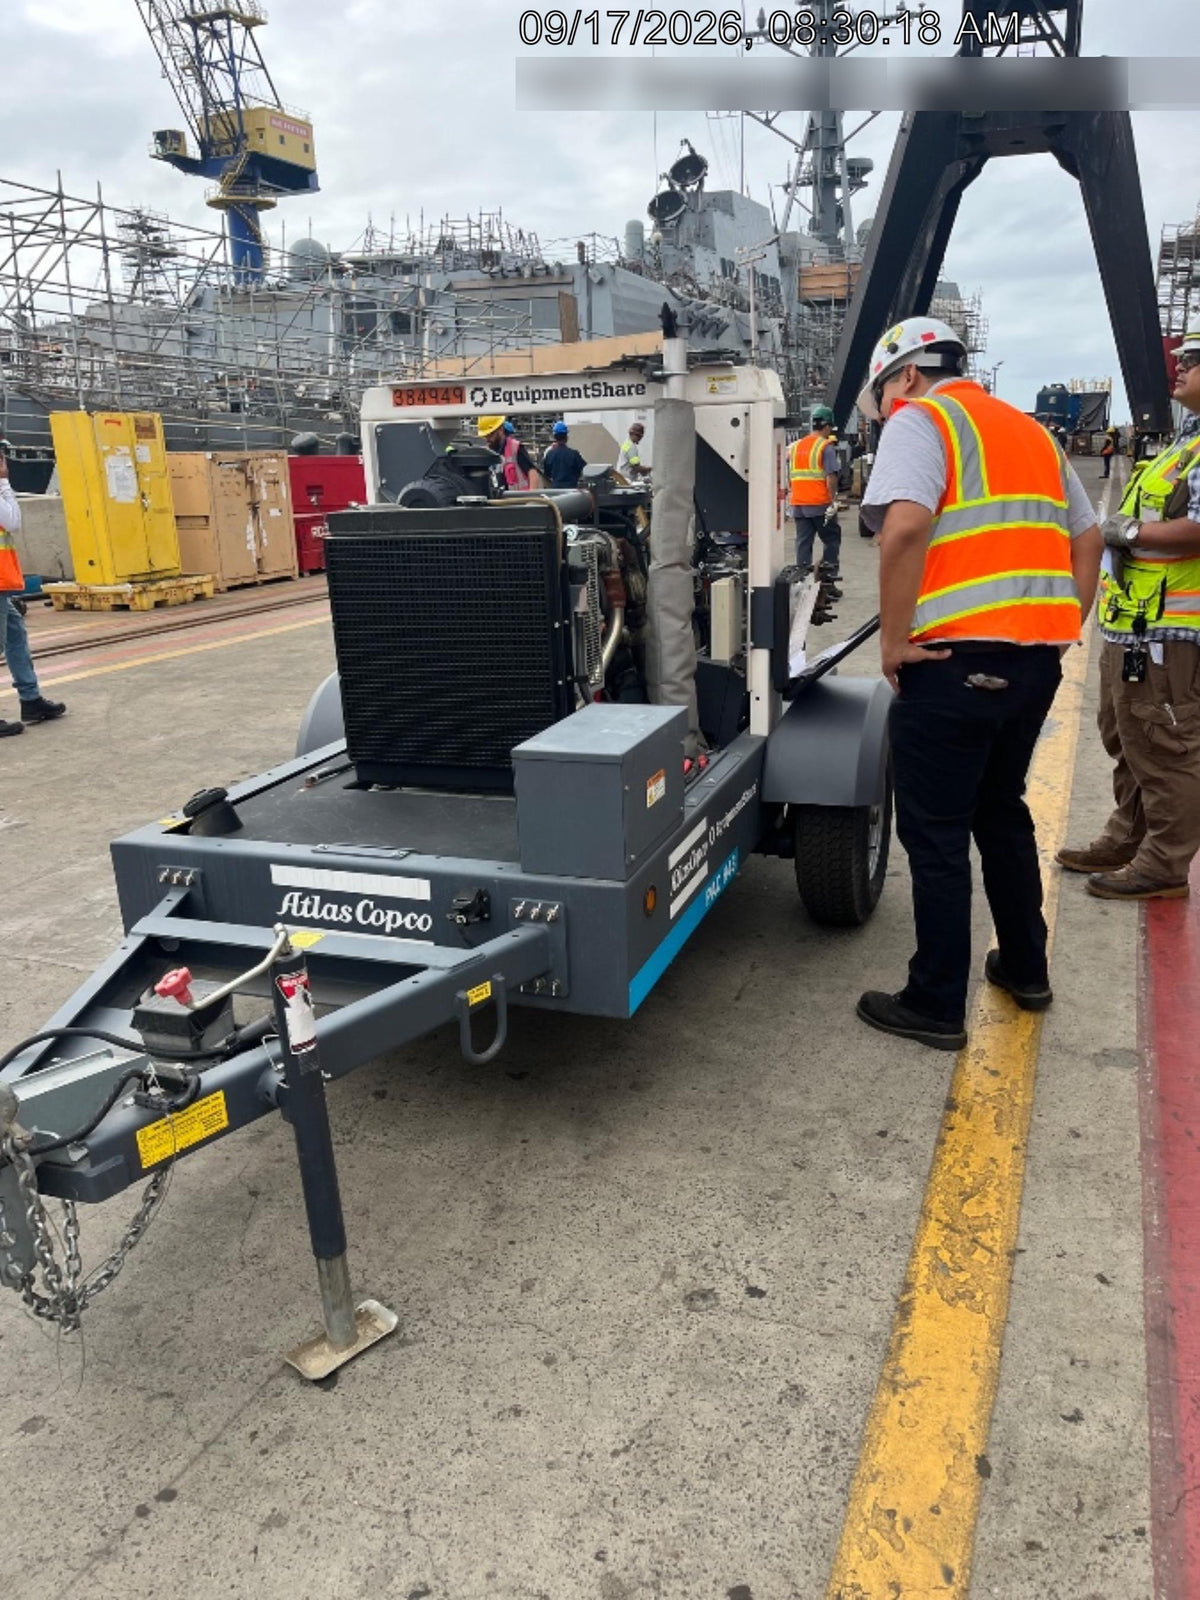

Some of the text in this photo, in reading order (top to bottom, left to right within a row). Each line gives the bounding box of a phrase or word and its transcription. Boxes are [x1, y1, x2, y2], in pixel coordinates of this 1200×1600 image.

[393, 387, 465, 406] 384949
[490, 381, 646, 406] EquipmentShare
[276, 891, 433, 933] Atlas Copco
